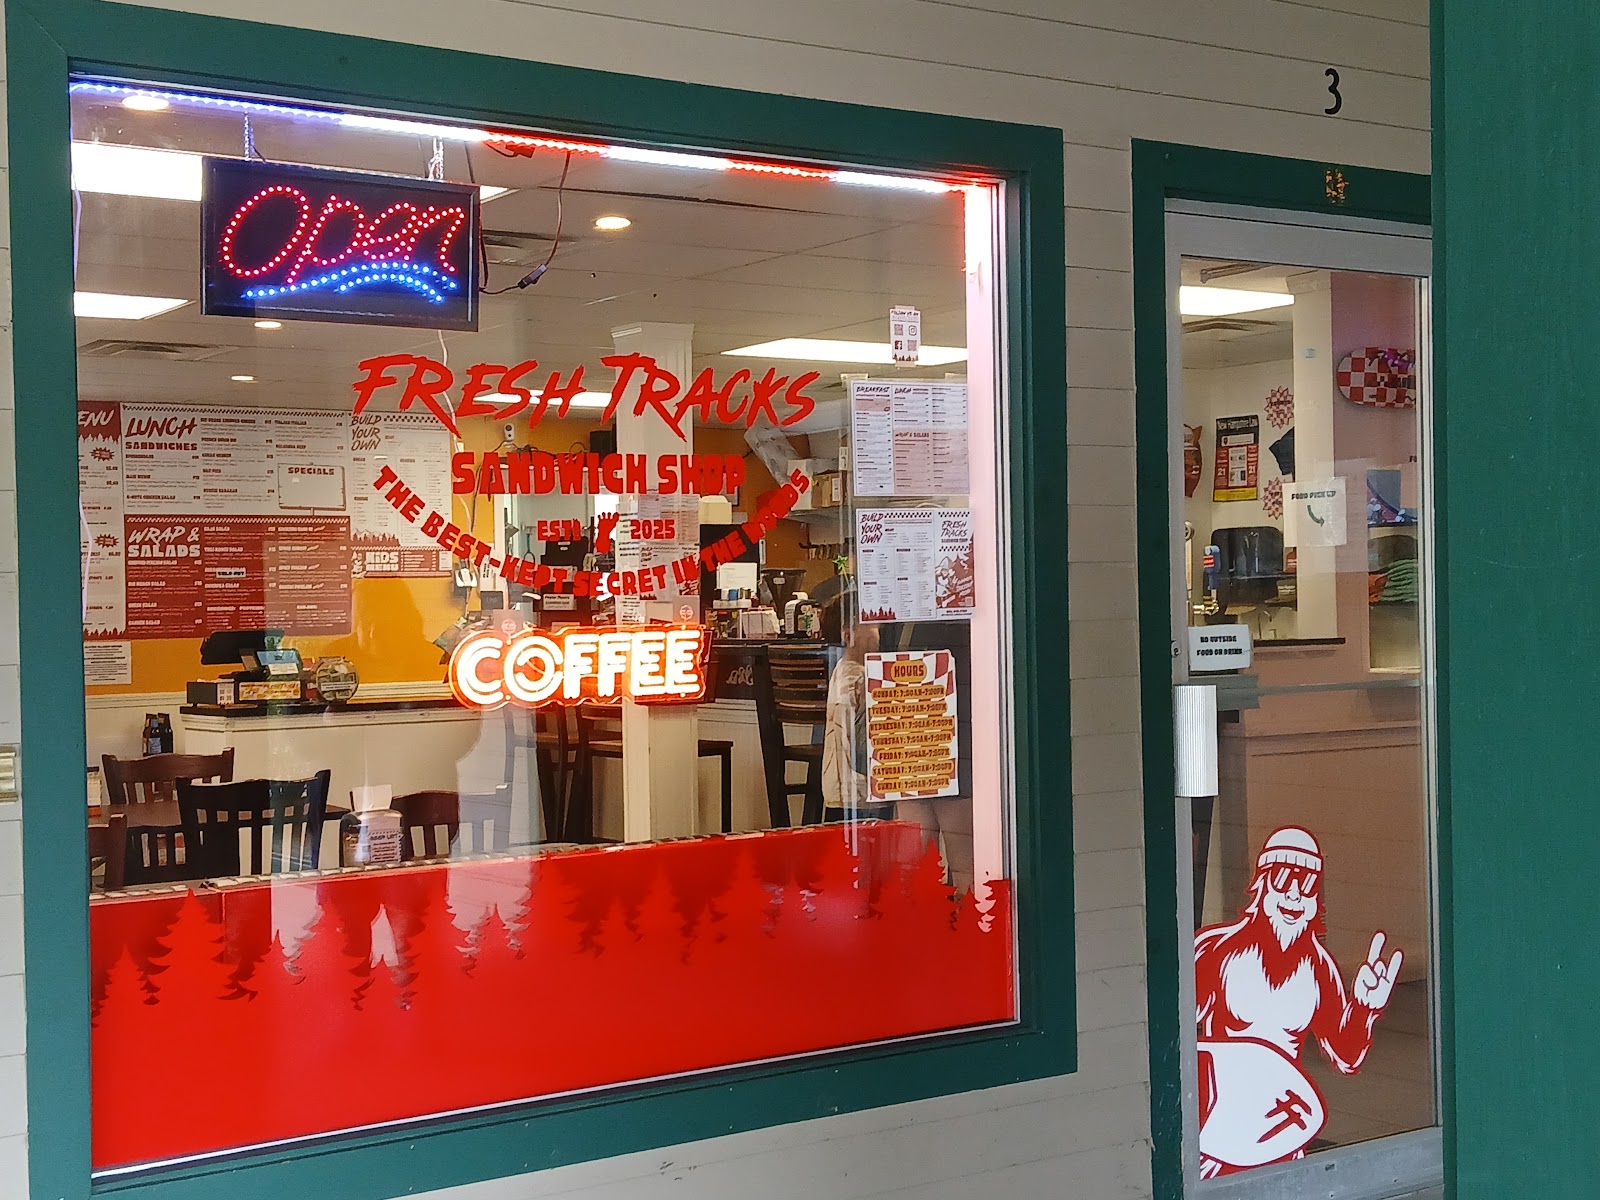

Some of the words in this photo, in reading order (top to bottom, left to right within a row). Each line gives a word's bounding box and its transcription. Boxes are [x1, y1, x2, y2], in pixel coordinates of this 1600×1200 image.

[1325, 68, 1342, 115] 3
[218, 185, 465, 285] Open
[352, 353, 585, 438] FRESH
[599, 352, 820, 442] TRACKS
[78, 409, 114, 427] ENU
[349, 414, 382, 427] BUILD
[124, 416, 197, 439] LUNCH
[351, 426, 381, 442] YOUR
[125, 441, 198, 451] SANDWICHES
[351, 440, 380, 451] OWN
[288, 467, 335, 476] SPECIALS
[451, 451, 647, 496] SANDWICH
[657, 452, 746, 496] SHOP
[860, 513, 884, 523] BUILD
[373, 465, 426, 523] THE
[573, 565, 667, 597] SECRET
[672, 554, 700, 584] IN
[700, 530, 747, 572] THE
[630, 519, 676, 540] 2025
[861, 523, 883, 536] YOUR
[942, 520, 967, 530] FRESH
[128, 525, 186, 546] WRAP
[187, 526, 200, 542] &
[941, 528, 968, 537] TRACKS
[860, 535, 882, 544] OWN
[128, 544, 201, 557] SALADS
[366, 551, 399, 563] KIDS
[456, 630, 701, 704] COFFEE
[894, 665, 924, 677] HOURS
